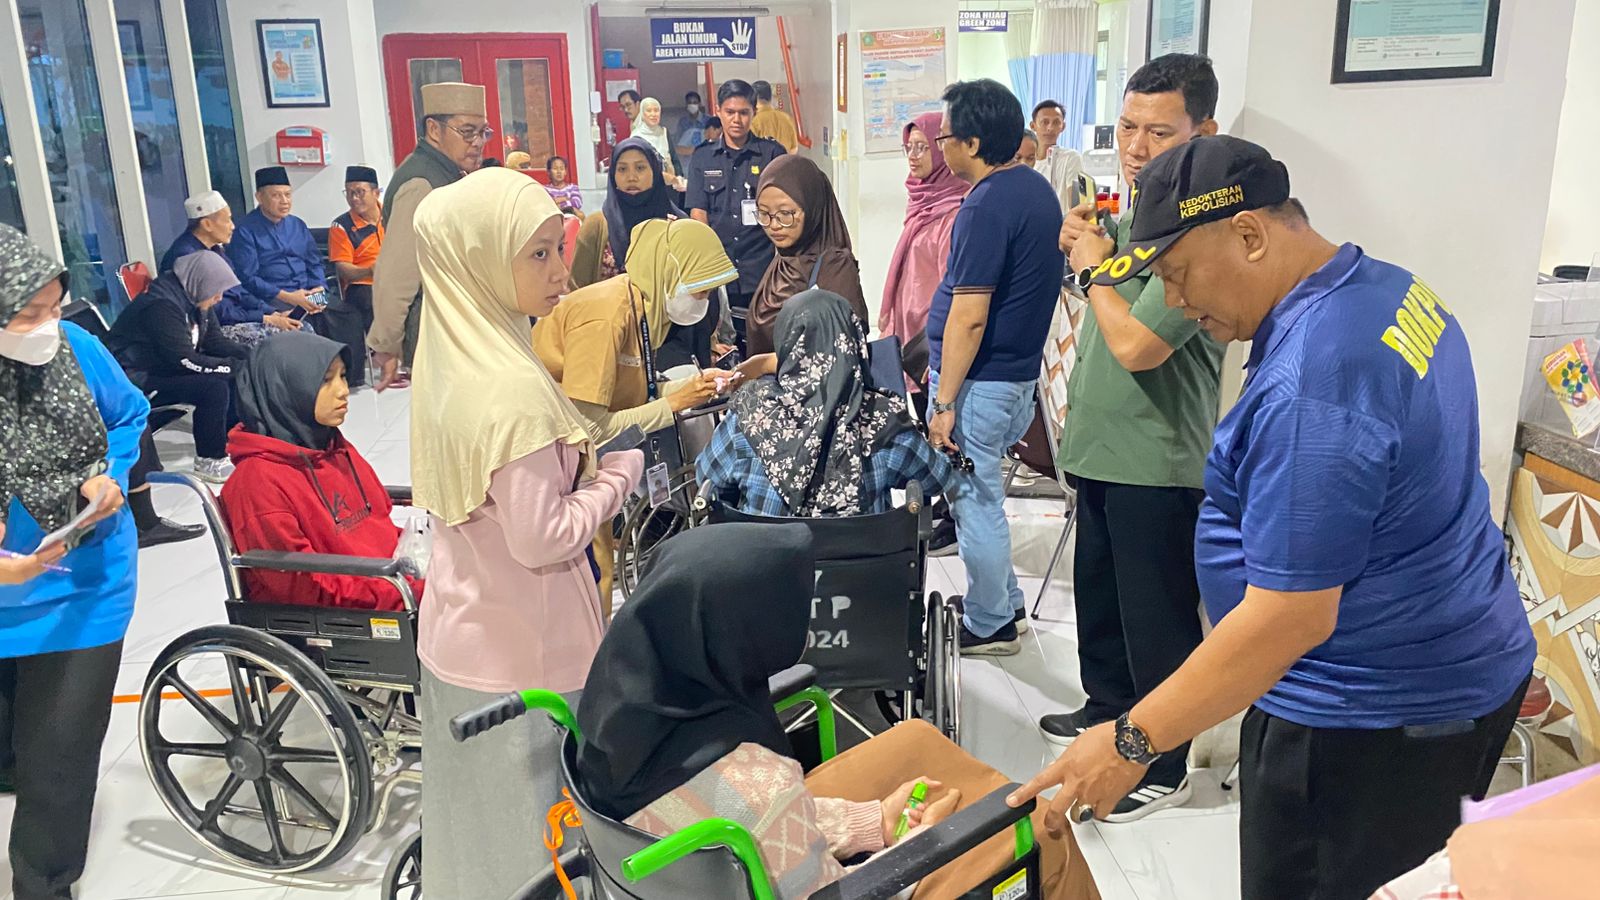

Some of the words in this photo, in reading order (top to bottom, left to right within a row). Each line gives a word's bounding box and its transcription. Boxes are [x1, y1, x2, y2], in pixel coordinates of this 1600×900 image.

[959, 11, 981, 19] ZONA
[982, 11, 1007, 19] HIJAU
[673, 22, 704, 33] BUKAN
[959, 19, 985, 27] GREEN
[985, 19, 1006, 27] ZONE
[661, 33, 687, 45] JALAN
[688, 33, 718, 44] UMUM
[655, 48, 674, 58] AREA
[674, 47, 725, 57] PERKANTORAN
[731, 43, 749, 51] STOP
[1178, 184, 1243, 209] KEDOKTERAN
[1180, 191, 1244, 219] KEPOLISIAN
